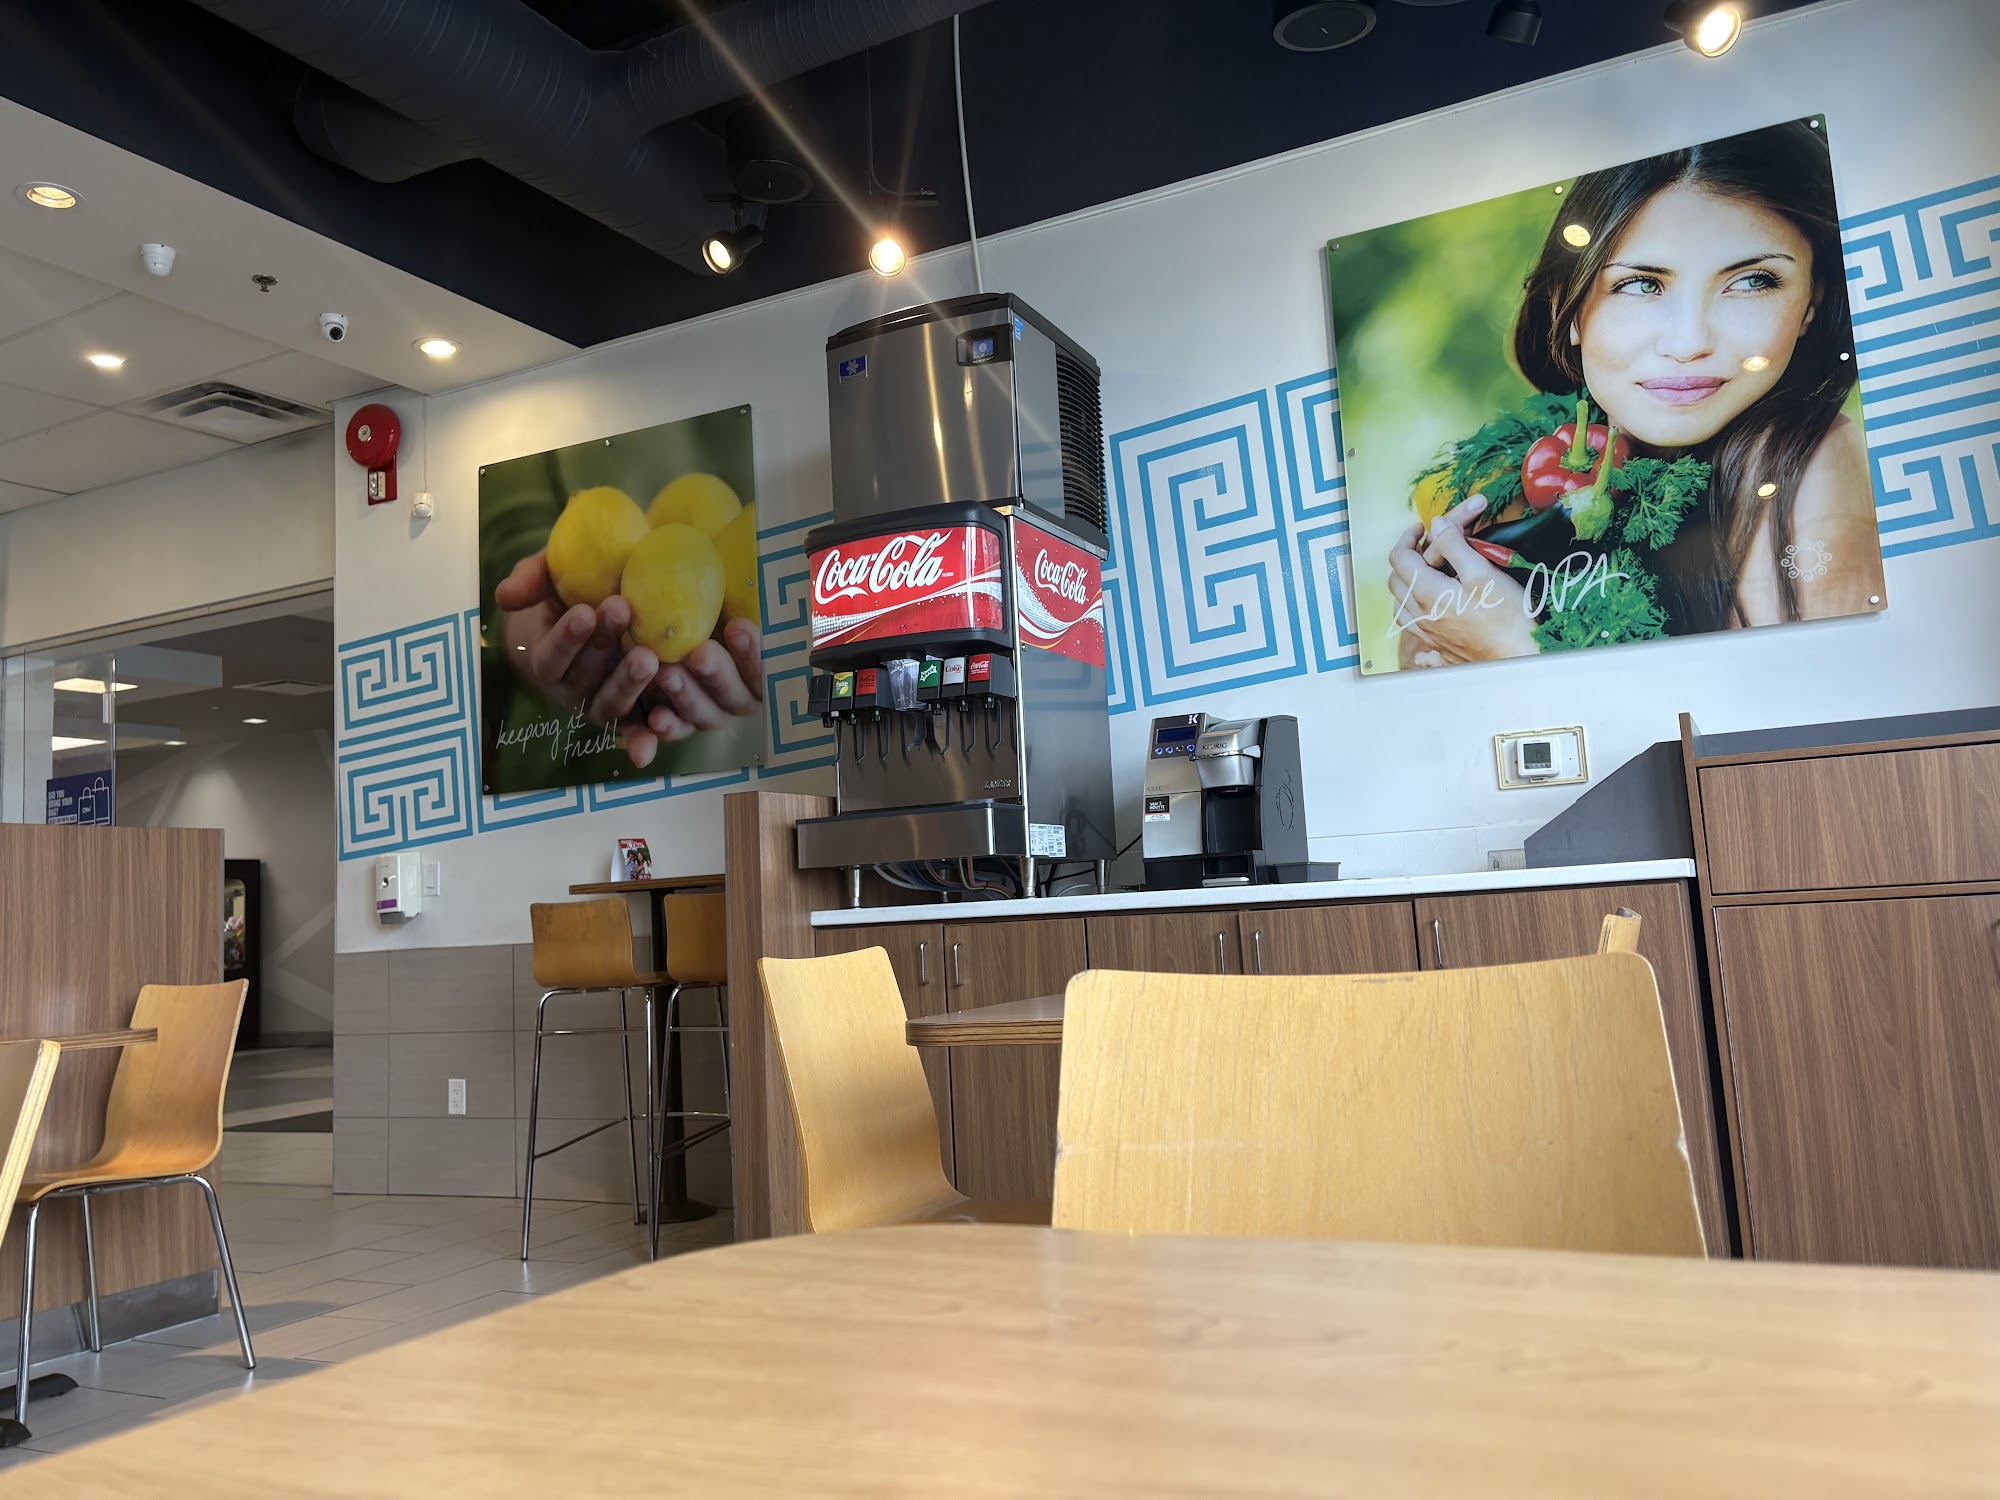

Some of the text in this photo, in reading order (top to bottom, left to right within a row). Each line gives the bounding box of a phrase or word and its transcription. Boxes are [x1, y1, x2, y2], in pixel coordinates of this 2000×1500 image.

[815, 528, 953, 605] Coca-Cola
[1034, 548, 1088, 605] Coca-Cola
[1385, 550, 1630, 639] Love OPA
[496, 698, 587, 761] keeping it
[1202, 742, 1228, 751] KEURIG
